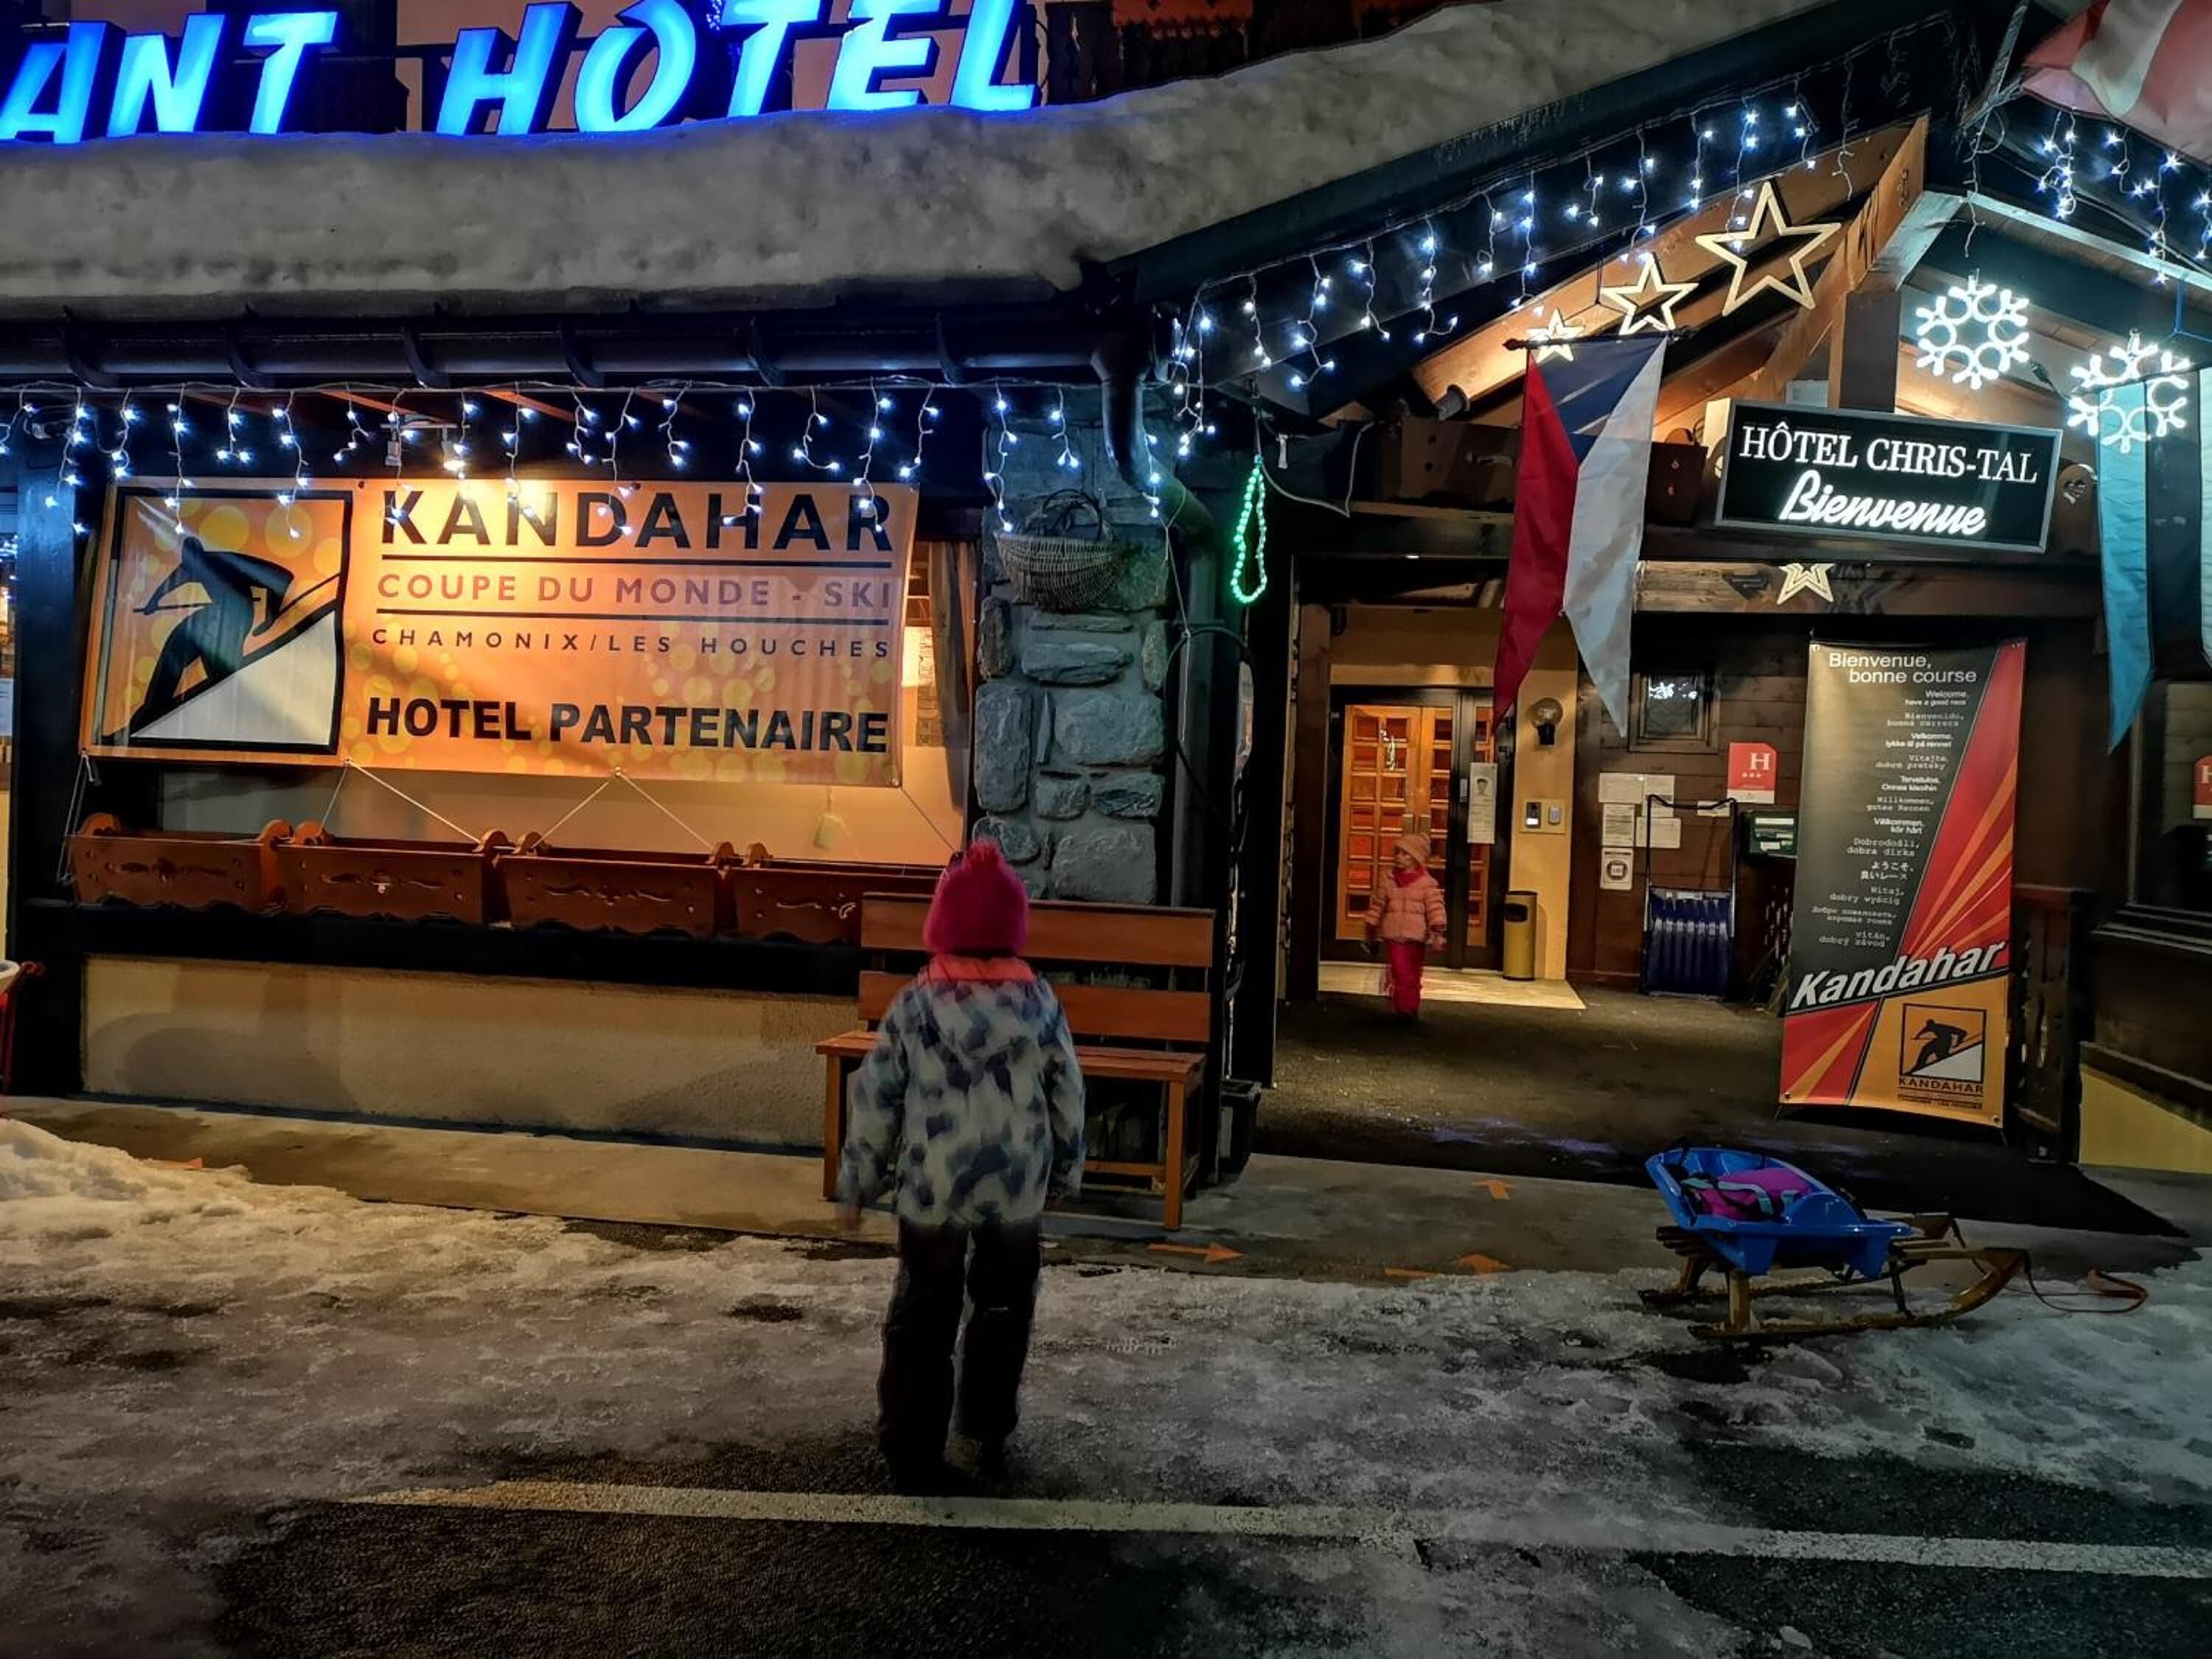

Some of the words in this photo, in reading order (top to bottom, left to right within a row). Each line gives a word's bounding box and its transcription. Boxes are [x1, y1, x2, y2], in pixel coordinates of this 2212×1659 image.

[0, 11, 338, 144] ANT
[437, 0, 1041, 136] HOTEL
[1739, 421, 1857, 467] HÔTEL
[1866, 438, 2038, 484] CHRIS-TAL
[382, 490, 894, 552] KANDAHAR
[1778, 470, 1987, 536] Bienvenue
[377, 574, 516, 602] COUPE
[538, 577, 594, 602] DU
[616, 577, 769, 606] MONDE
[824, 582, 889, 609] SKI
[700, 636, 888, 658] HOUCHES
[1829, 652, 1932, 669] Bienvenue,
[1849, 668, 1907, 684] bonne
[1913, 669, 1977, 684] course
[366, 696, 532, 741] HOTEL
[549, 702, 889, 754] PARTENAIRE
[1749, 752, 1771, 771] H
[1790, 941, 2006, 1009] Kandahar
[1899, 1077, 1983, 1093] KANDAHAR
